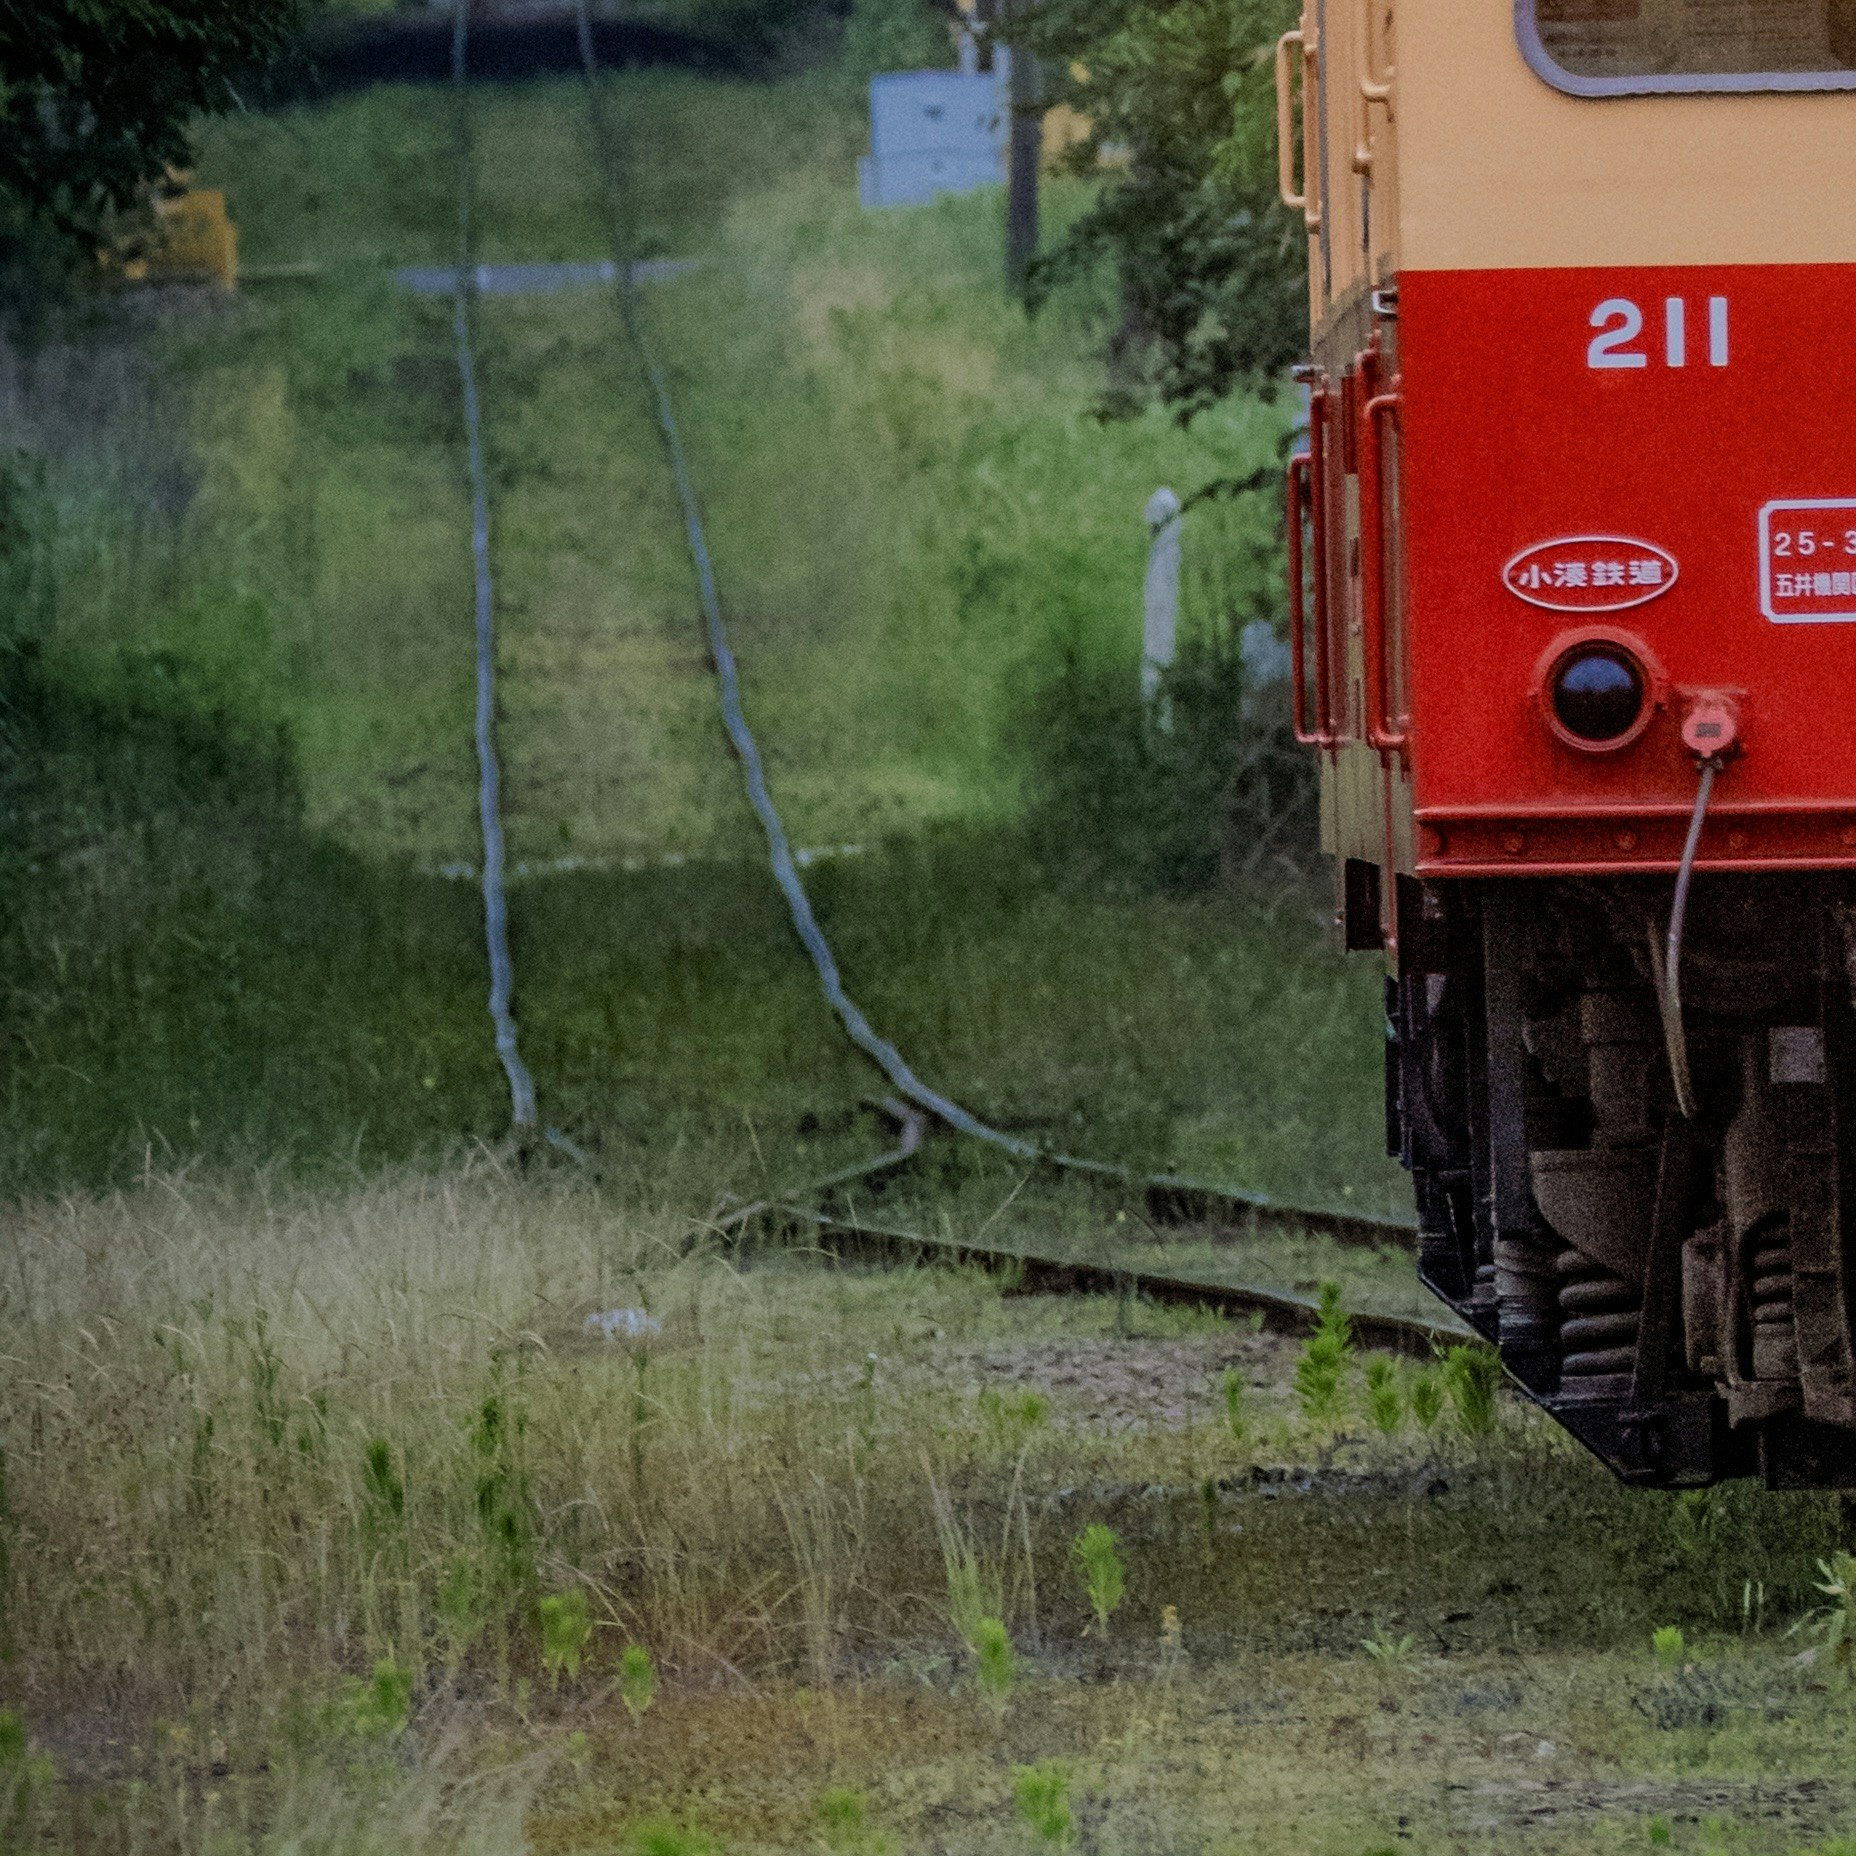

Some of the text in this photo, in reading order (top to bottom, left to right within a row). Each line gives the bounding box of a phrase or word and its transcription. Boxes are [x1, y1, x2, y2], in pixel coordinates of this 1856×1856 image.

[1587, 296, 1729, 369] 211
[1518, 558, 1664, 590] 小湊鉄道
